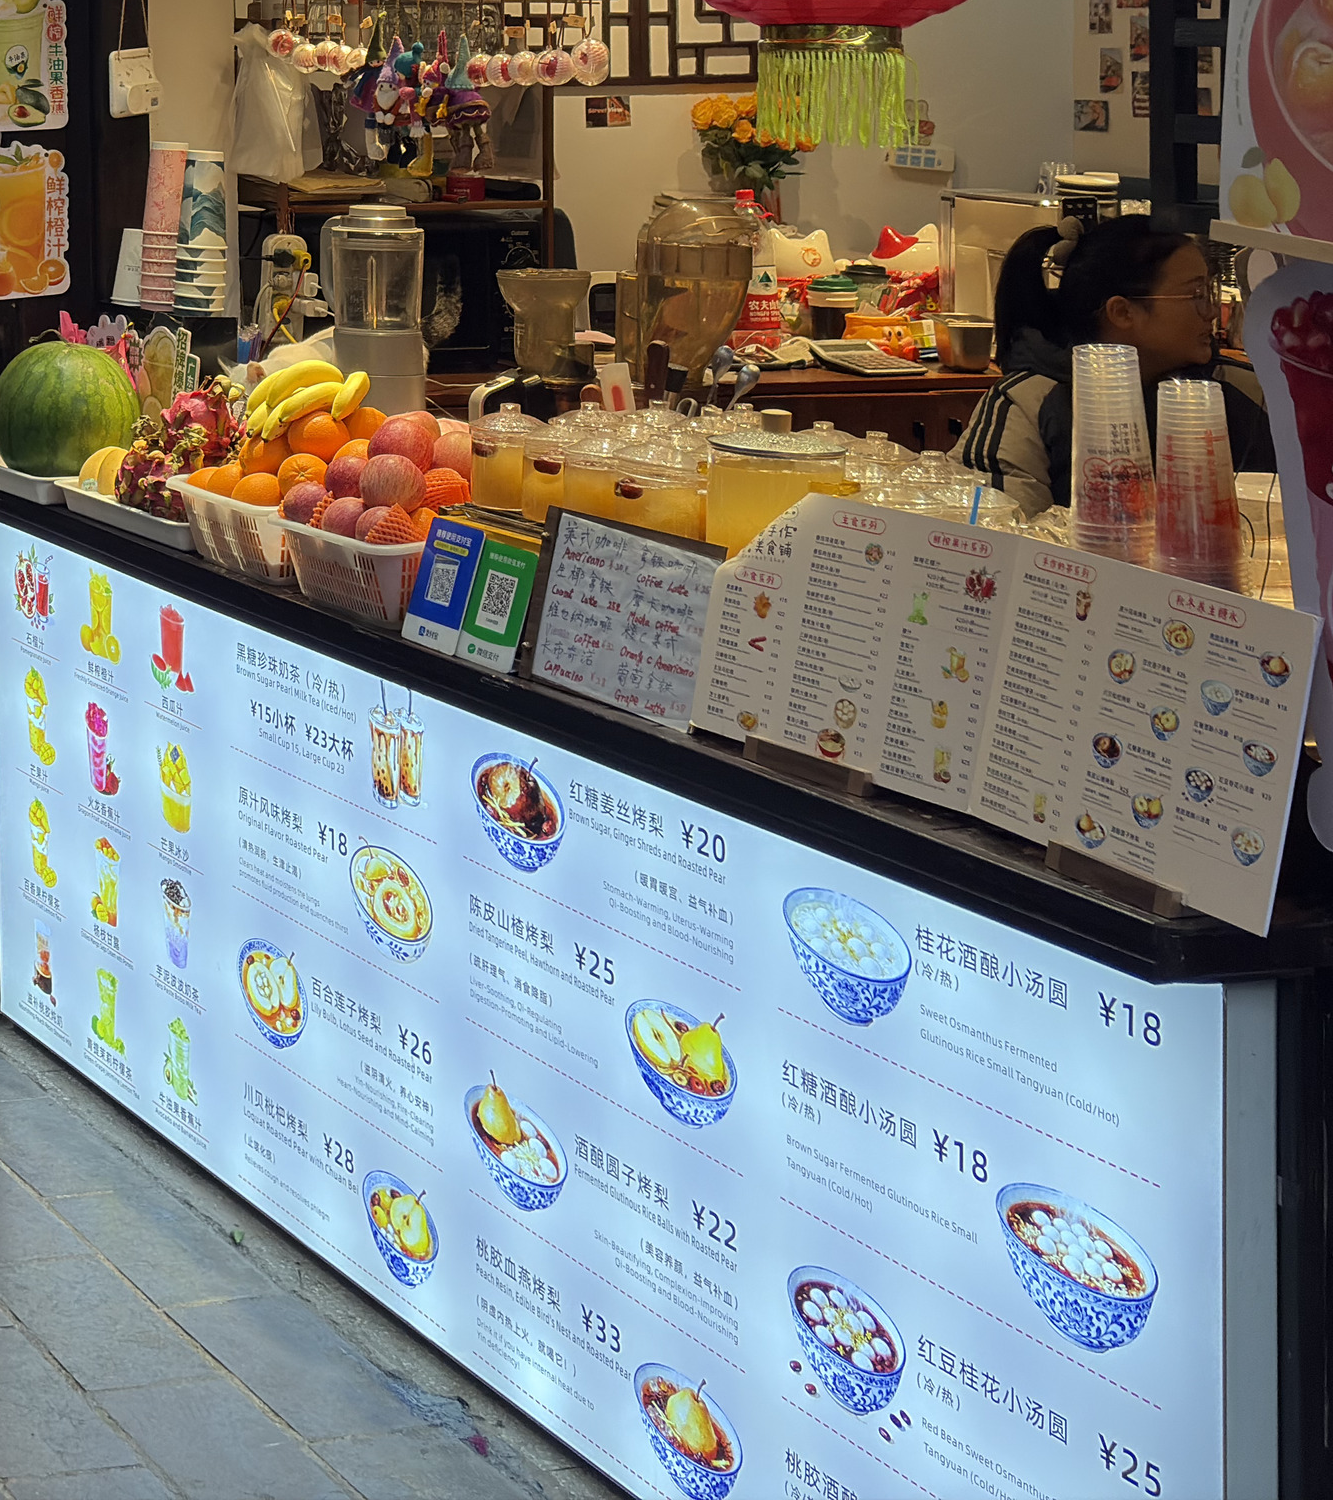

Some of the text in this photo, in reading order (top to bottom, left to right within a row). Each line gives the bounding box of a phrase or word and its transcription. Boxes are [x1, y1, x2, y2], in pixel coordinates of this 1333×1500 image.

[47, 176, 66, 258] 鲜榨橙汁
[237, 642, 300, 684] 黑糖珍珠奶茶
[476, 647, 500, 662] 微信支付
[237, 665, 255, 680] Brown
[257, 673, 275, 688] Sugar
[277, 680, 293, 696] Pearl
[294, 688, 307, 702] Milk
[308, 694, 320, 707] Tea
[251, 700, 295, 736] ¥15小杯
[305, 723, 353, 760] ¥23大杯
[239, 786, 303, 834] 原汁风味烤梨
[569, 780, 664, 838] 红糖姜丝烤梨
[318, 822, 347, 856] ¥18
[681, 820, 725, 862] ¥20
[470, 894, 554, 955] 陈皮山楂烤梨
[575, 942, 614, 984] ¥25
[915, 924, 1067, 1010] 桂花酒酿小汤圆
[311, 976, 381, 1034] 百合莲子烤梨
[1098, 992, 1161, 1046] ¥18
[398, 1024, 431, 1064] ¥26
[921, 1028, 964, 1056] Glutinous
[966, 1048, 985, 1066] Rice
[987, 1058, 1014, 1079] Small
[1015, 1070, 1063, 1101] Tangyuan
[244, 1083, 308, 1142] 川贝枇杷烤梨
[782, 1061, 916, 1149] 红糖酒酿小汤圆
[323, 1133, 353, 1173] ¥28
[575, 1134, 669, 1211] 酒酿圆子烤梨
[933, 1128, 987, 1182] ¥18
[692, 1200, 737, 1252] ¥22
[476, 1236, 561, 1312] 桃胶血燕烤梨
[581, 1304, 620, 1352] ¥33
[918, 1336, 1067, 1445] 红豆桂花小汤圆
[1098, 1433, 1161, 1496] ¥25
